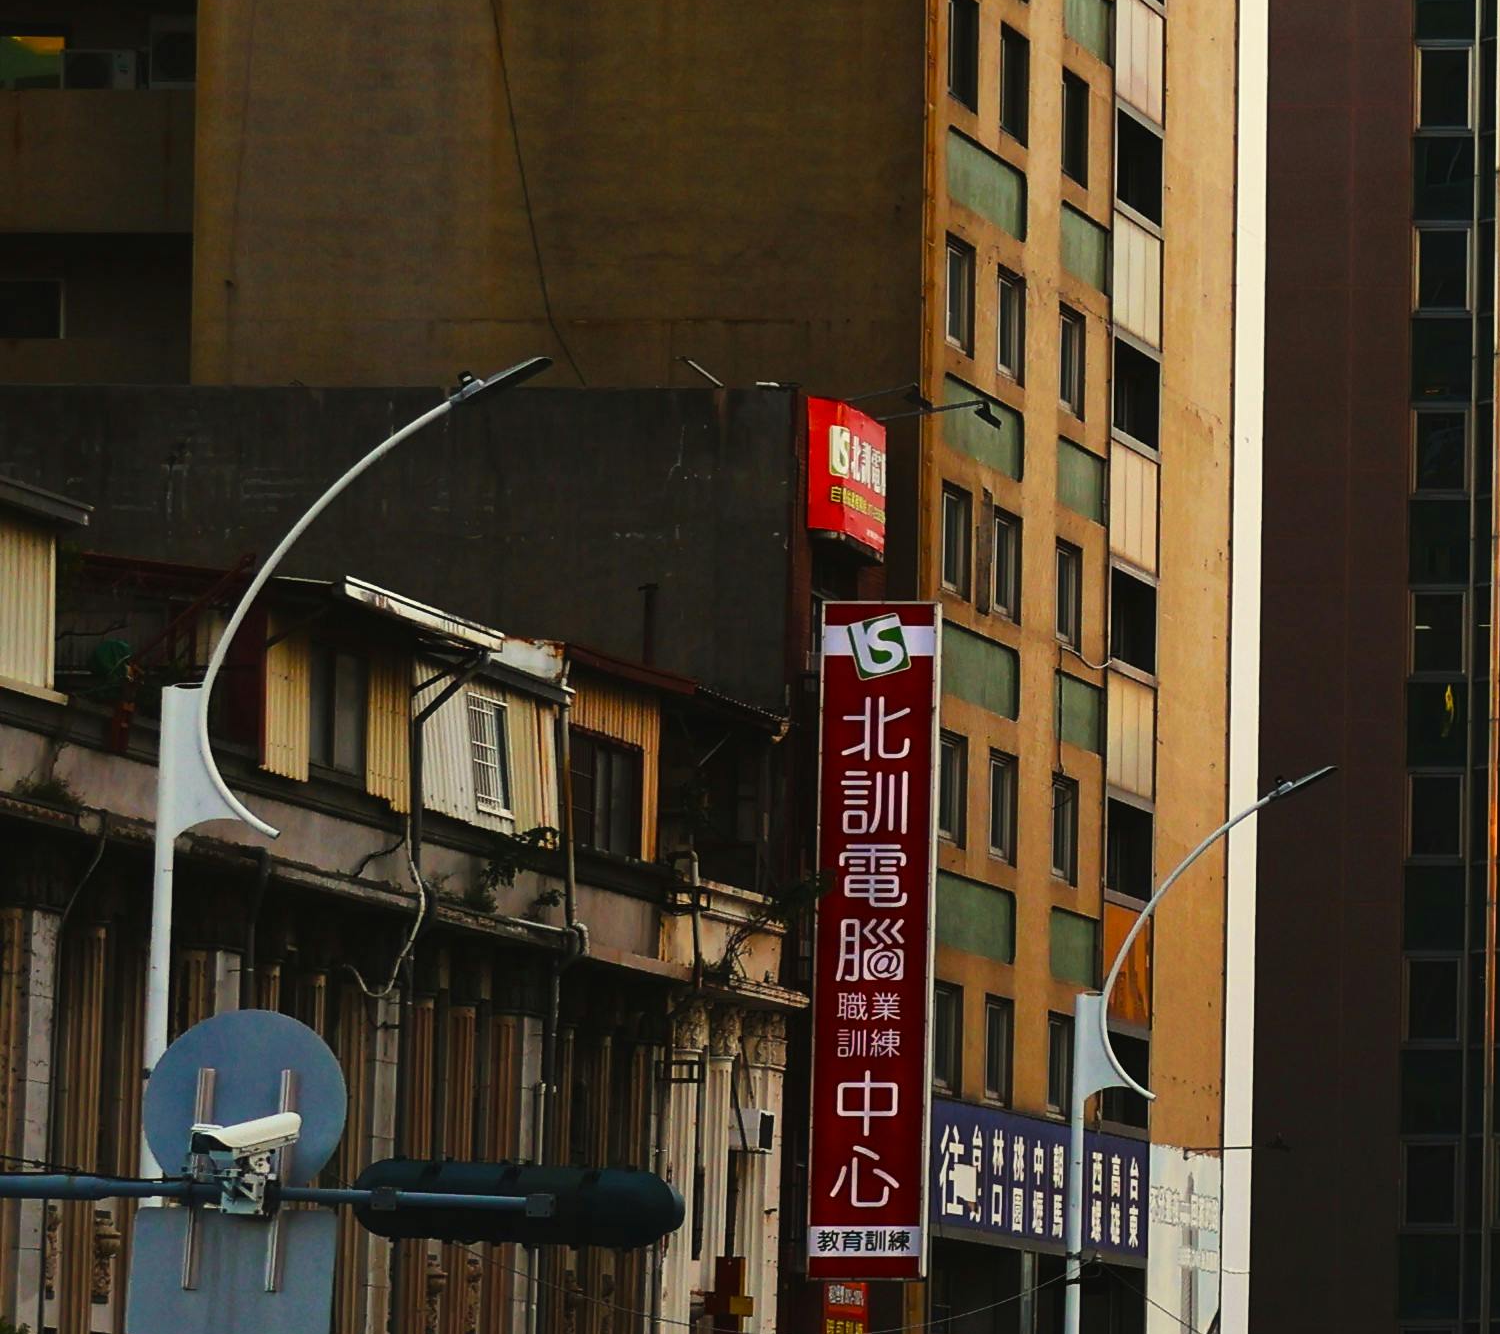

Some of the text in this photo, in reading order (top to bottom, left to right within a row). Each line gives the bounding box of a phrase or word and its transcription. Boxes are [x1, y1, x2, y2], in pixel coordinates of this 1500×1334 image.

[851, 433, 886, 497] 北訓電
[837, 991, 902, 1021] 職業
[837, 1027, 902, 1060] 訓練
[828, 1069, 901, 1210] 中心
[991, 1129, 1005, 1227] 林口
[1011, 1133, 1026, 1234] 桃園
[1032, 1139, 1044, 1235] 中壢
[1052, 1143, 1064, 1239] 朝馬
[1091, 1151, 1103, 1244] 西螺
[1110, 1153, 1122, 1246] 高雄
[1128, 1156, 1140, 1249] 台東
[816, 1228, 912, 1254] 教育訓練
